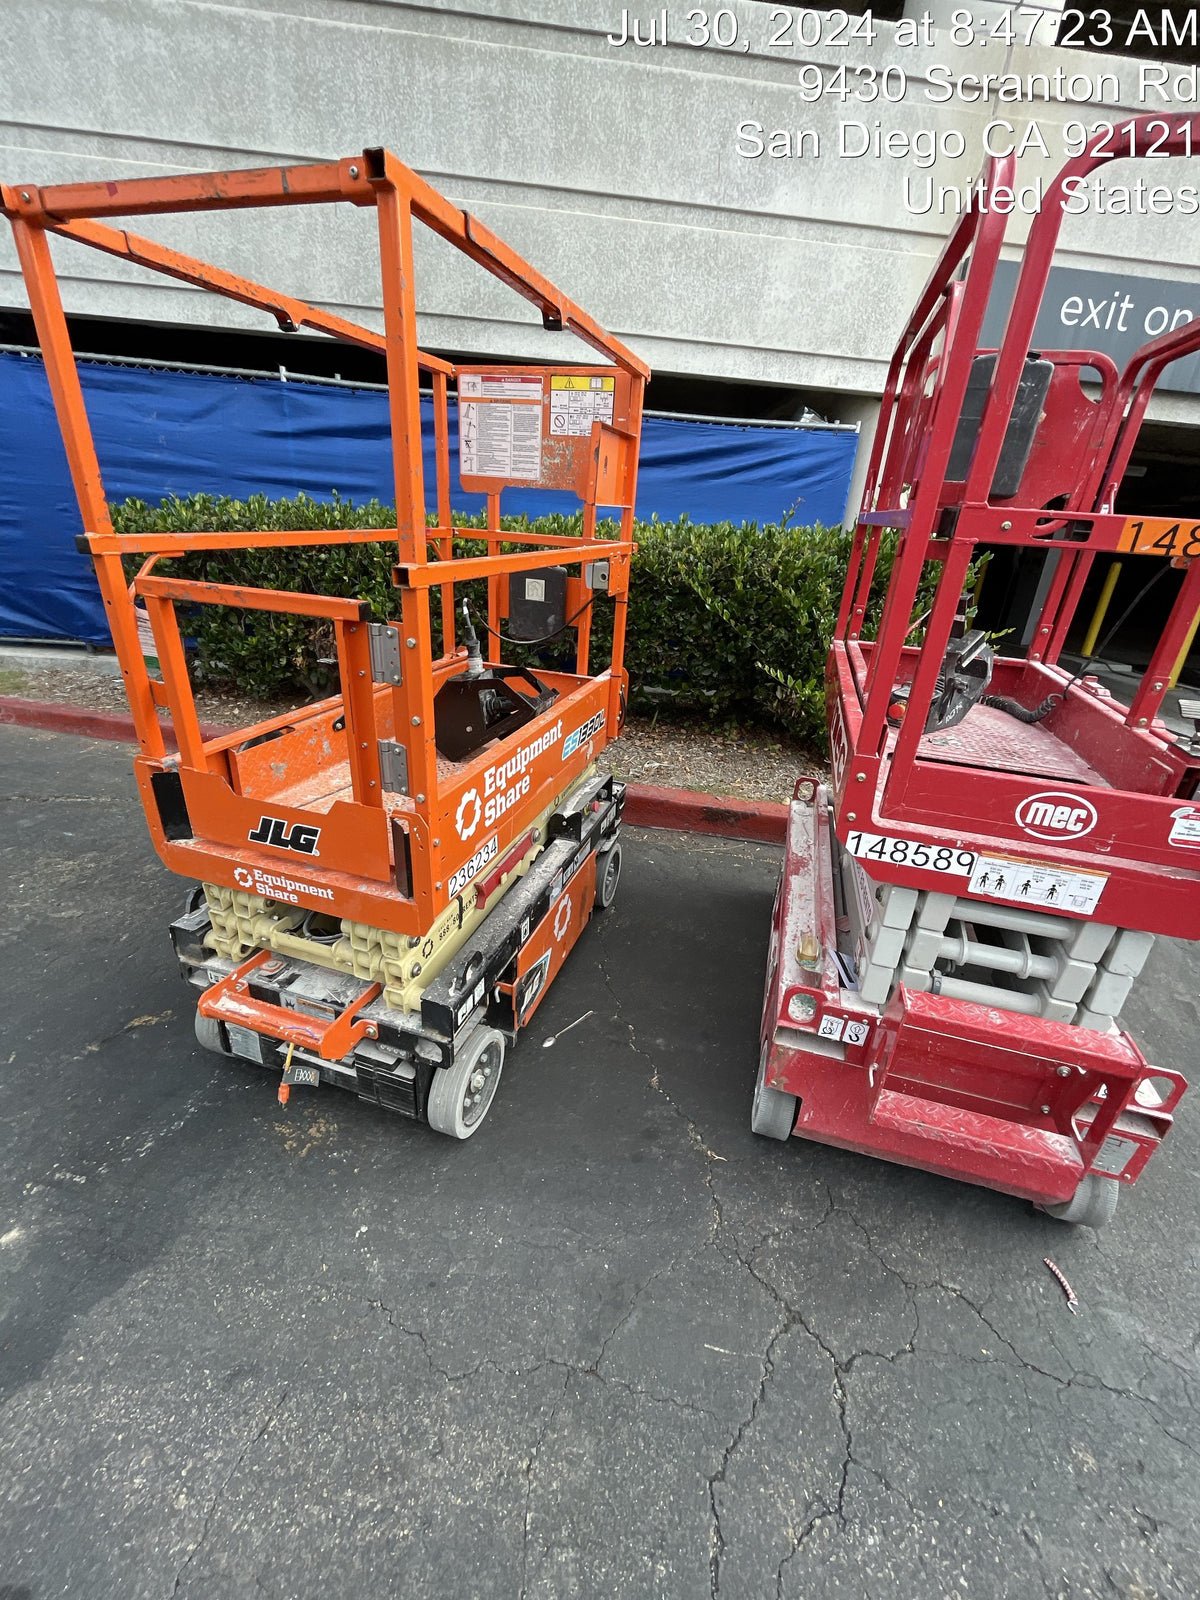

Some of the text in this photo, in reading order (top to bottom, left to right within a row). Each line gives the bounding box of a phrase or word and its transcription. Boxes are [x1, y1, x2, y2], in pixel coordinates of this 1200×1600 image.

[1060, 291, 1135, 332] exit
[483, 719, 563, 798] Equipment
[484, 774, 531, 828] Share
[247, 815, 321, 855] JLG
[850, 833, 976, 876] 148589
[252, 868, 335, 900] Equipment
[449, 838, 498, 898] 236234
[255, 882, 299, 904] Share
